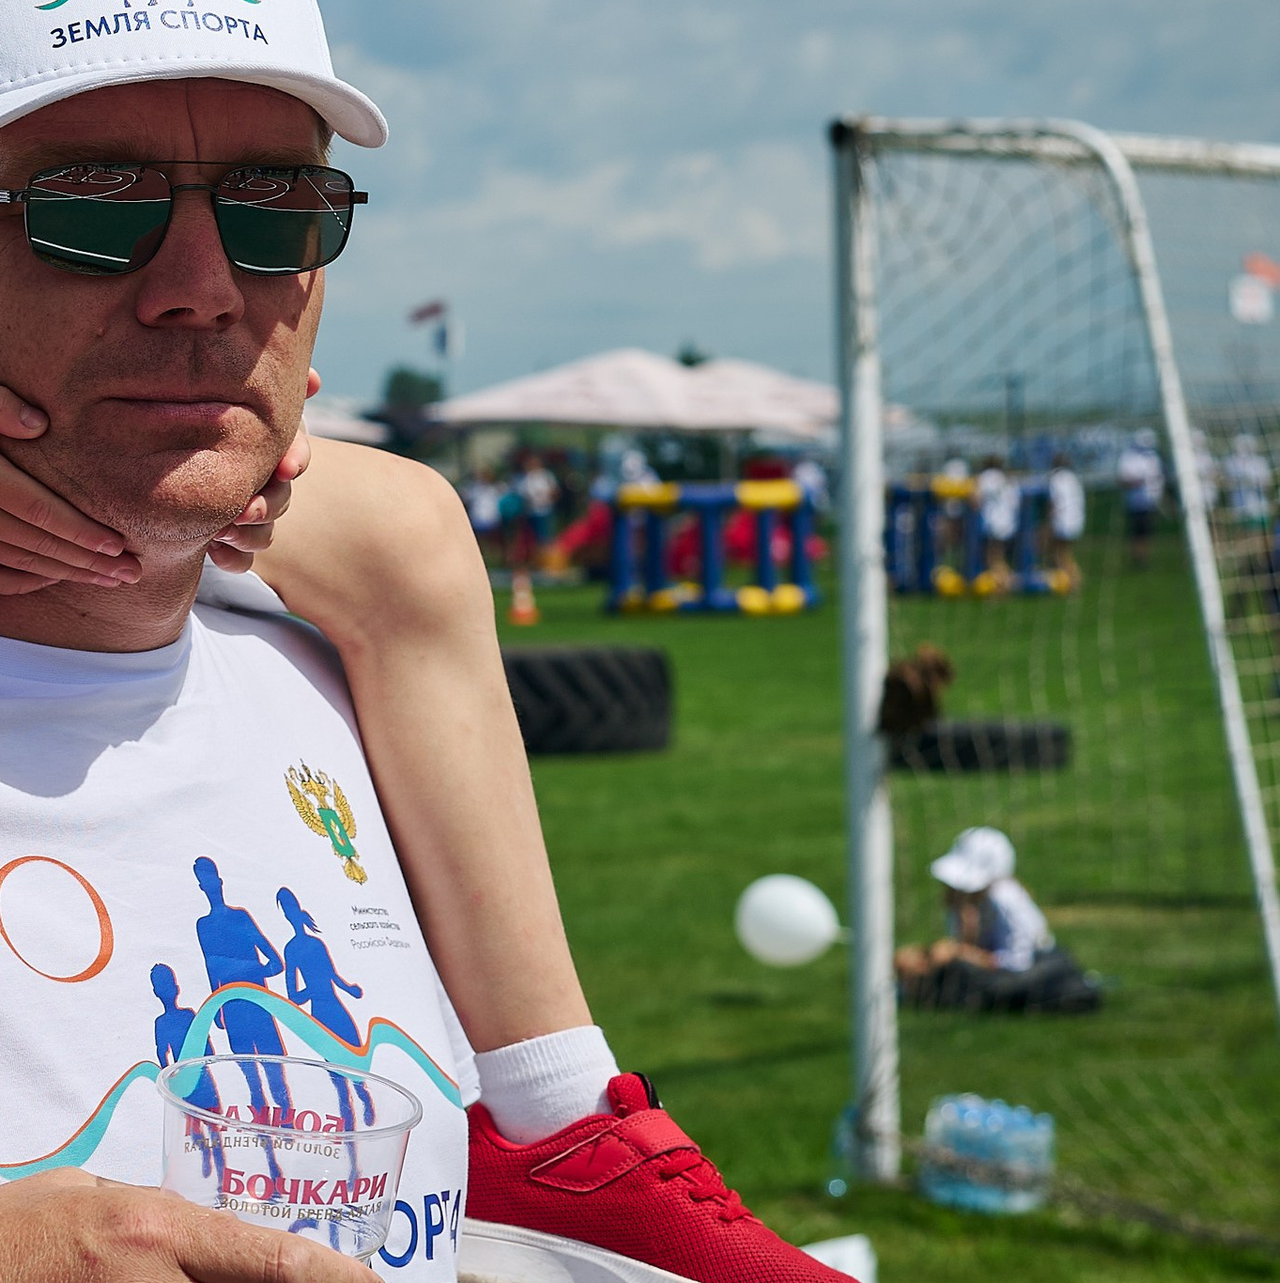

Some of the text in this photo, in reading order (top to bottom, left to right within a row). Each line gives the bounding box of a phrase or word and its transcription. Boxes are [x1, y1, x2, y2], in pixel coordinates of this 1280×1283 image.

[50, 10, 269, 49] ЗЕМЛЯ СПОРТА
[221, 1167, 388, 1206] БОЧКАРИ
[219, 1197, 383, 1221] ЗОЛОТОЙ БРЕНД АЛТАЯ
